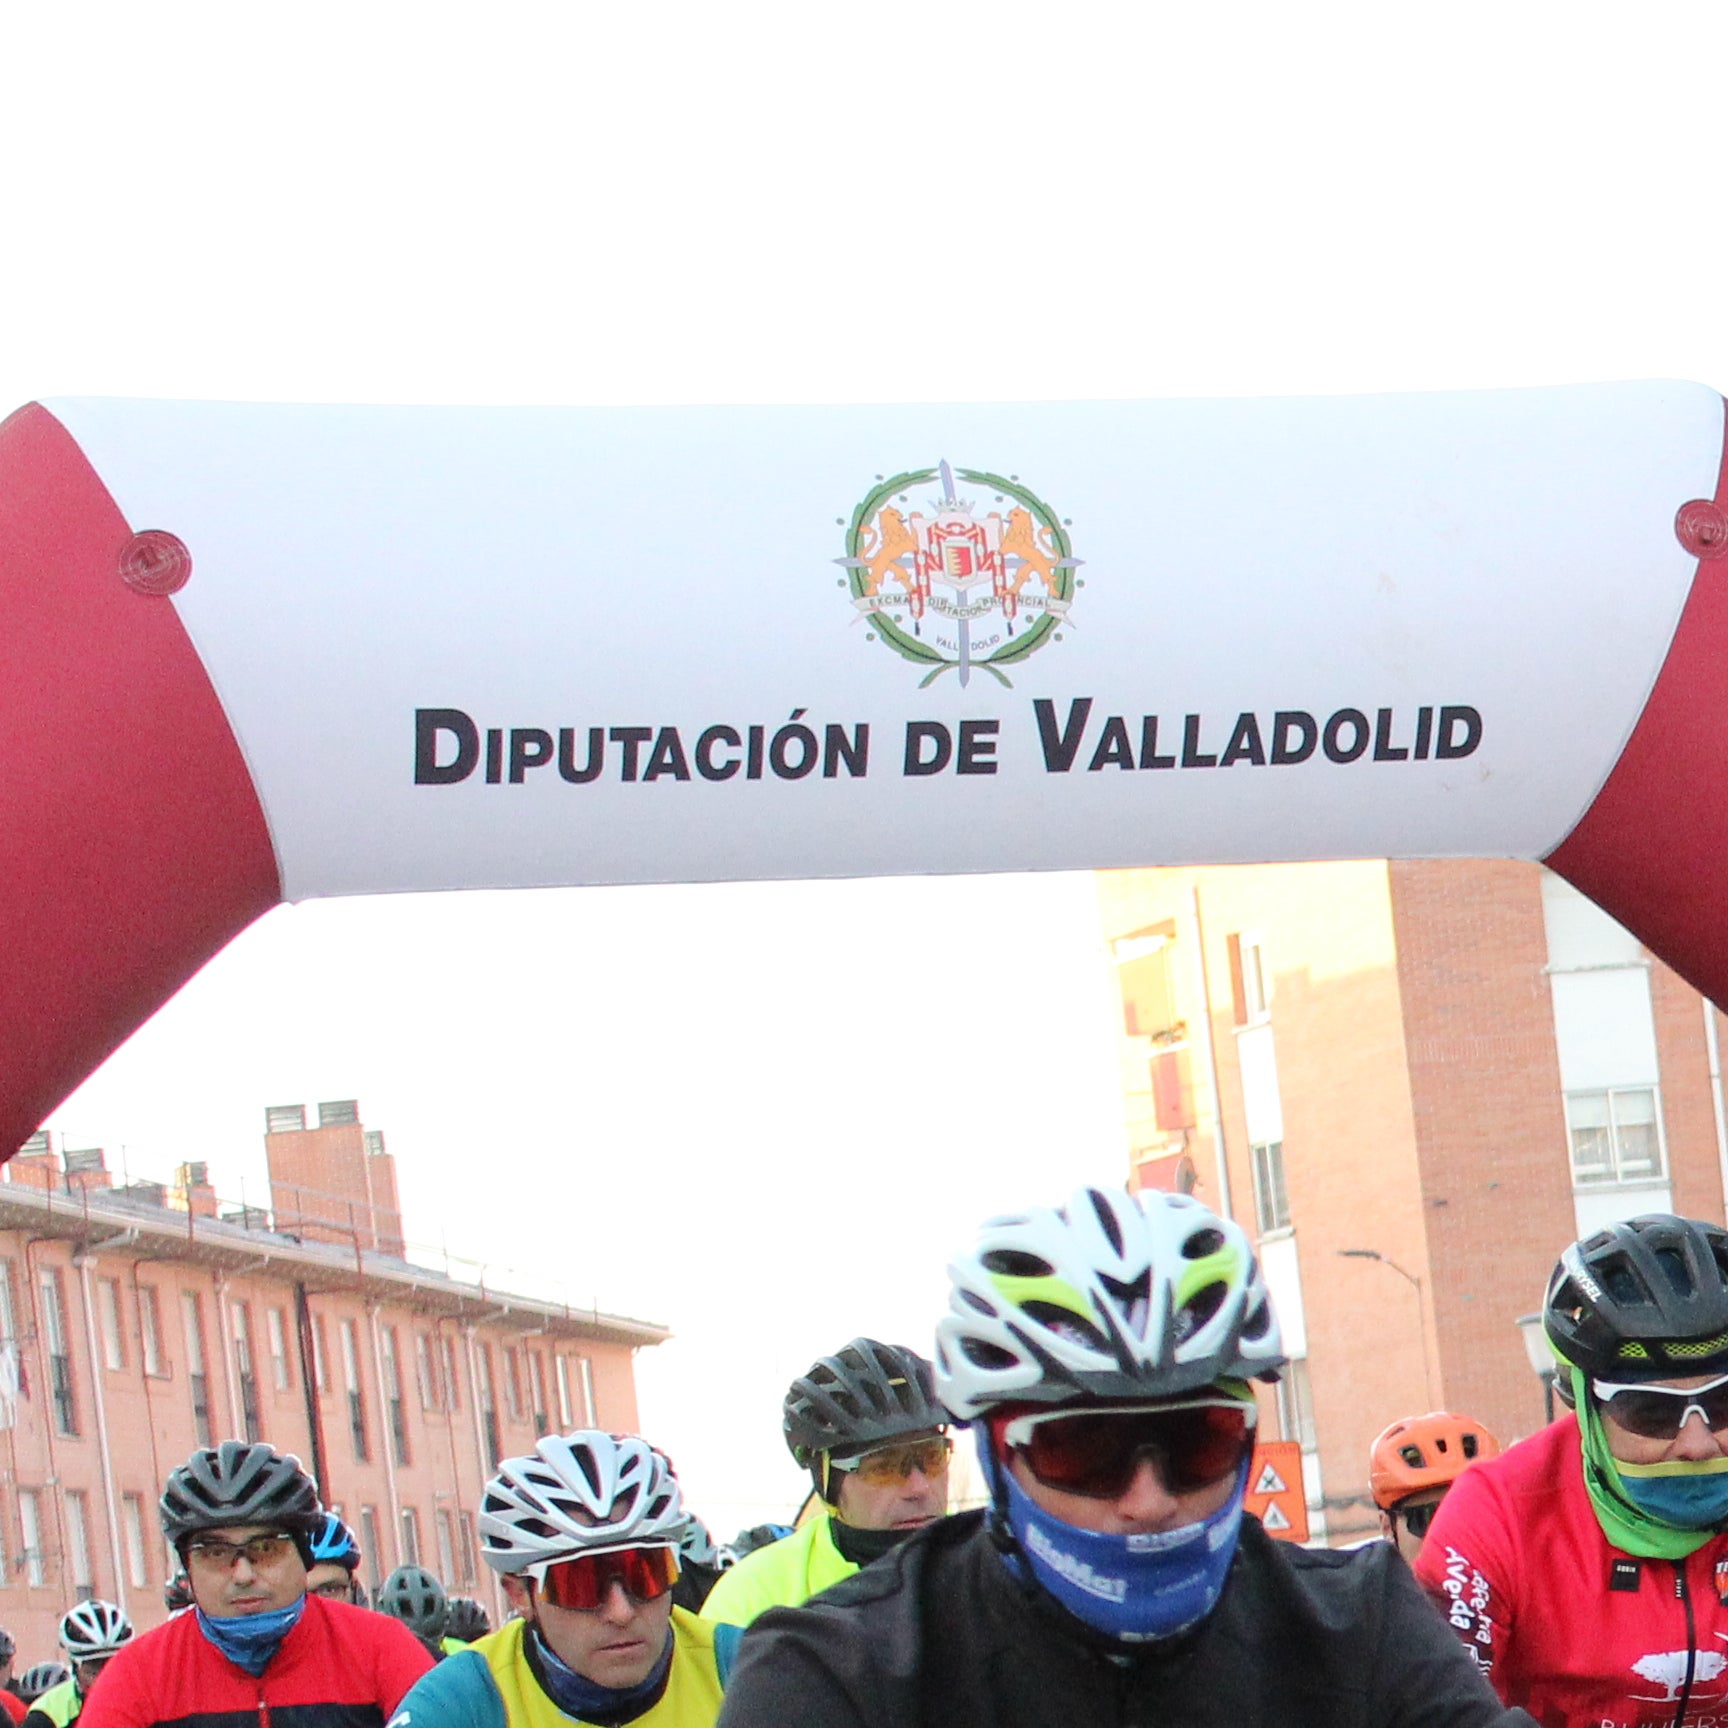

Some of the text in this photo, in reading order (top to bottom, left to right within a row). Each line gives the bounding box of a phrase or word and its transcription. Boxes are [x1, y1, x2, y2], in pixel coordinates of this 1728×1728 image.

[414, 696, 1484, 786] DIPUTACIÓN DE VALLADOLID
